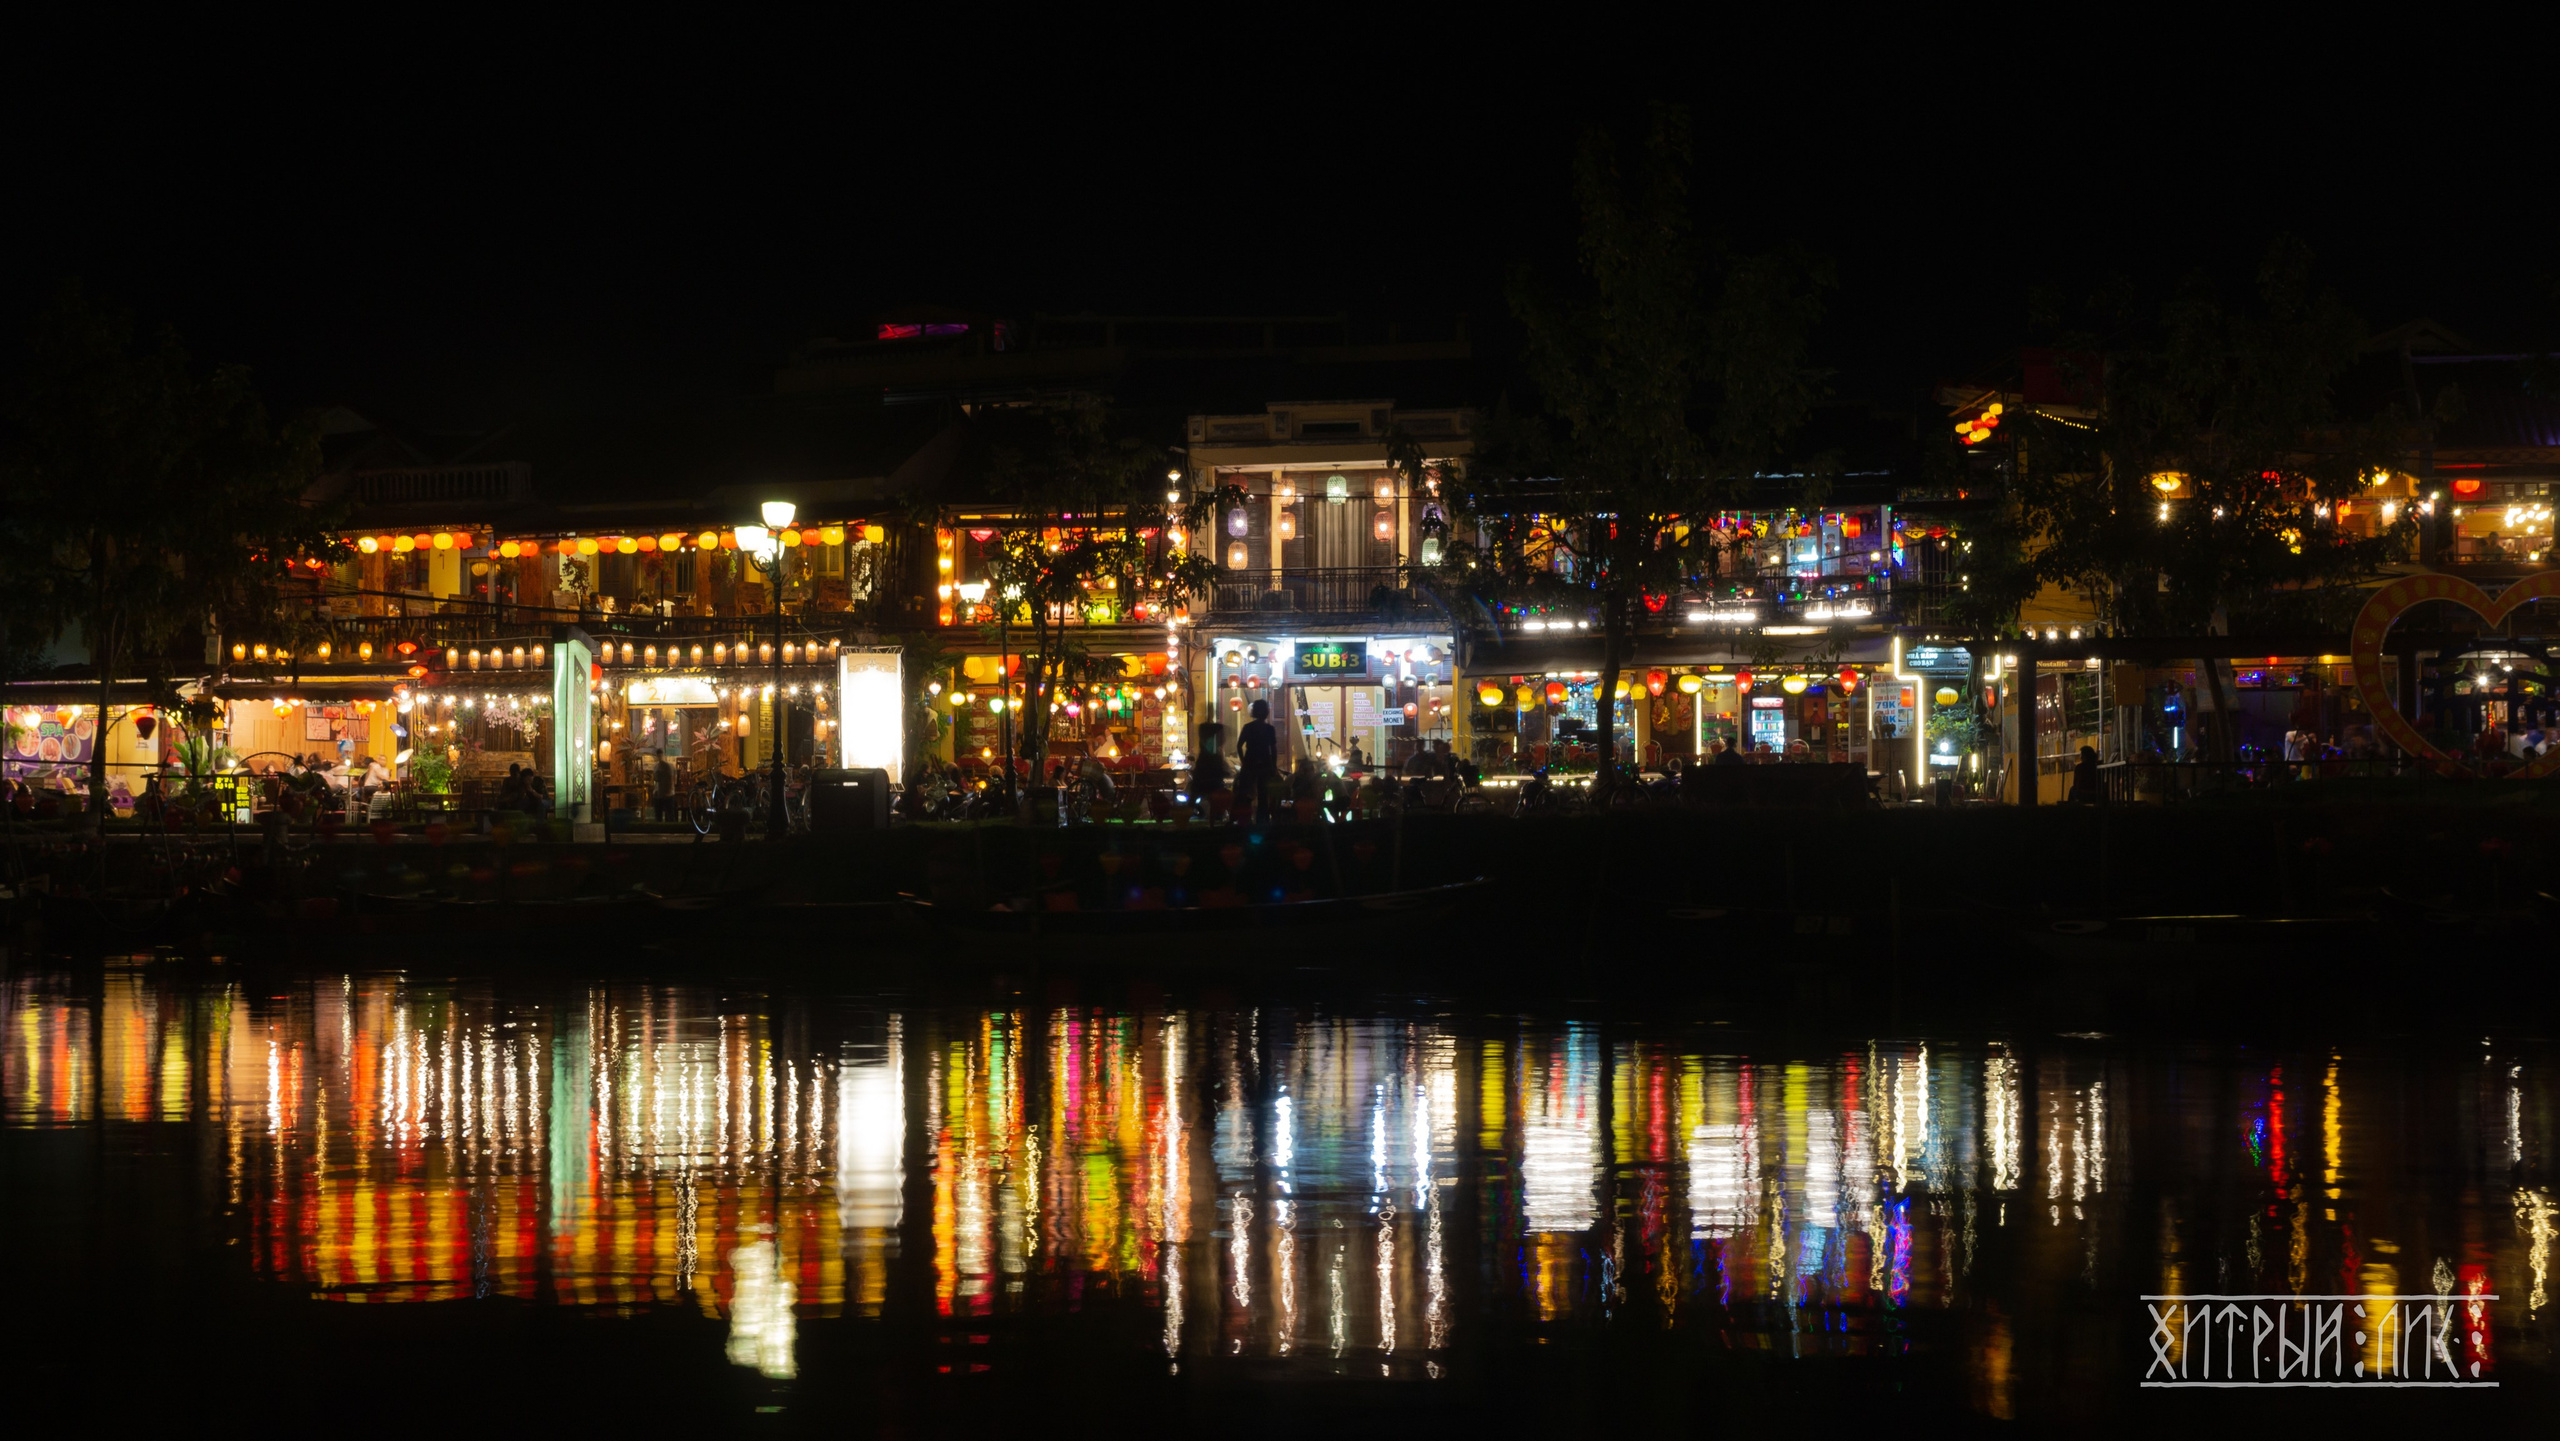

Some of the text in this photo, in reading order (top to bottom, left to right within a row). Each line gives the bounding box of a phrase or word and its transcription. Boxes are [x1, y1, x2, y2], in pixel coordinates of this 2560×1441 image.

[1349, 653, 1360, 667] 3
[1875, 701, 1896, 709] 79K
[41, 723, 64, 737] SPA
